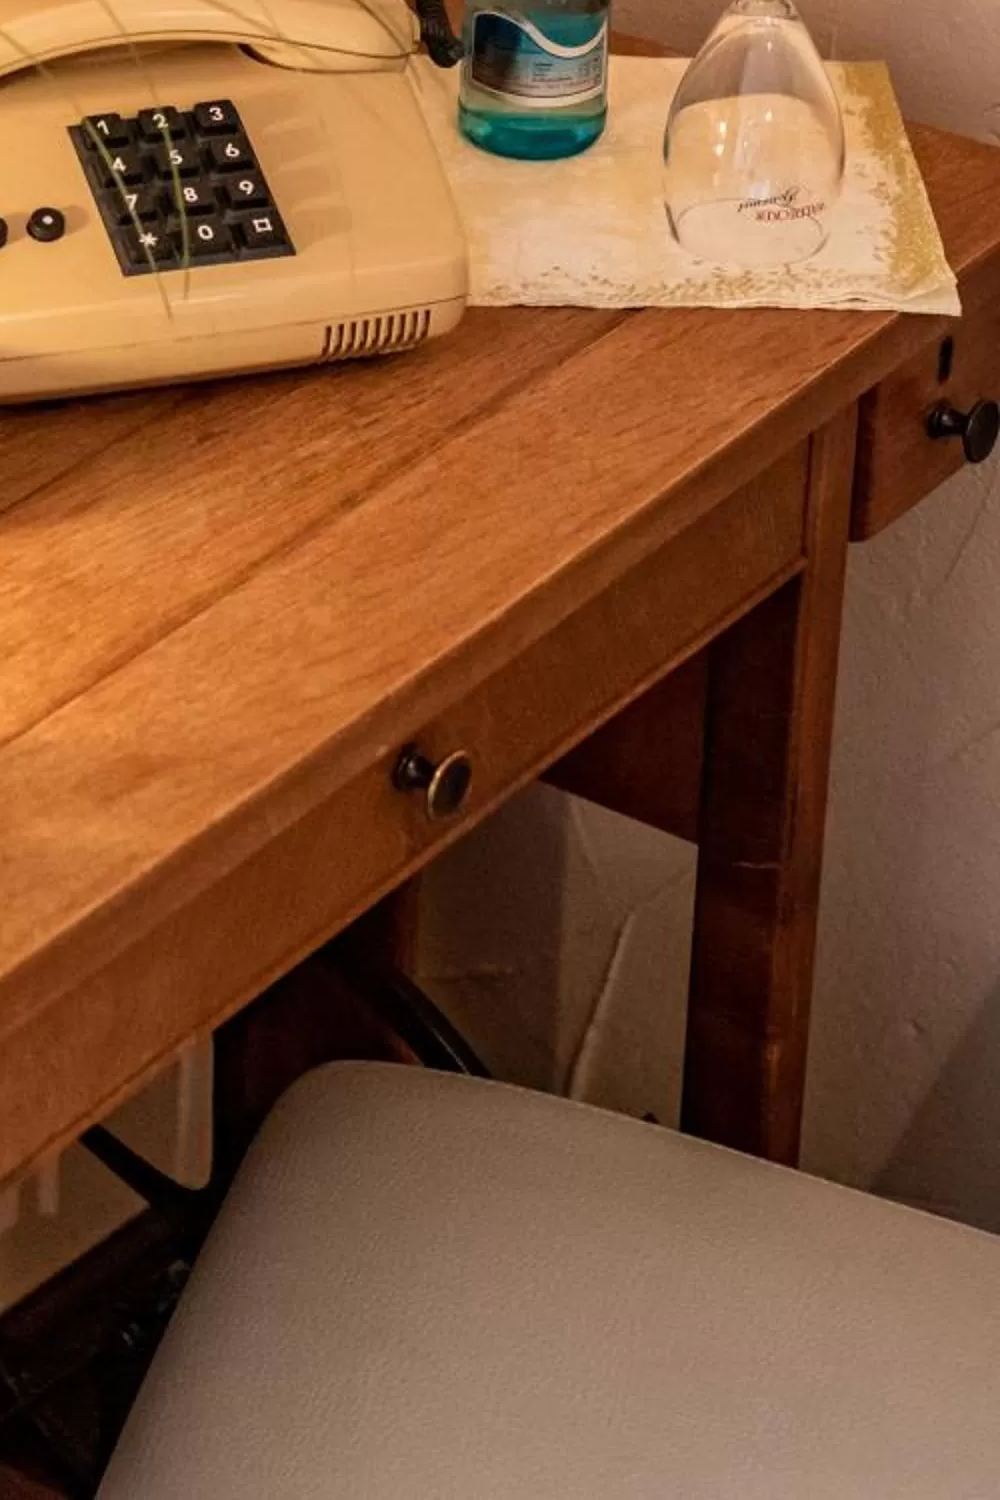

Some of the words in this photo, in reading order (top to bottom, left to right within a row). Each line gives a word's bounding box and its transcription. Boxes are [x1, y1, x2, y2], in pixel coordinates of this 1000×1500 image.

[97, 120, 110, 136] 1
[153, 114, 168, 129] 2
[209, 107, 224, 121] 3
[112, 157, 127, 173] 4
[169, 150, 183, 165] 5
[225, 143, 240, 157] 6
[124, 194, 138, 211] 7
[183, 187, 198, 203] 8
[239, 180, 254, 195] 9
[197, 225, 213, 241] 0
